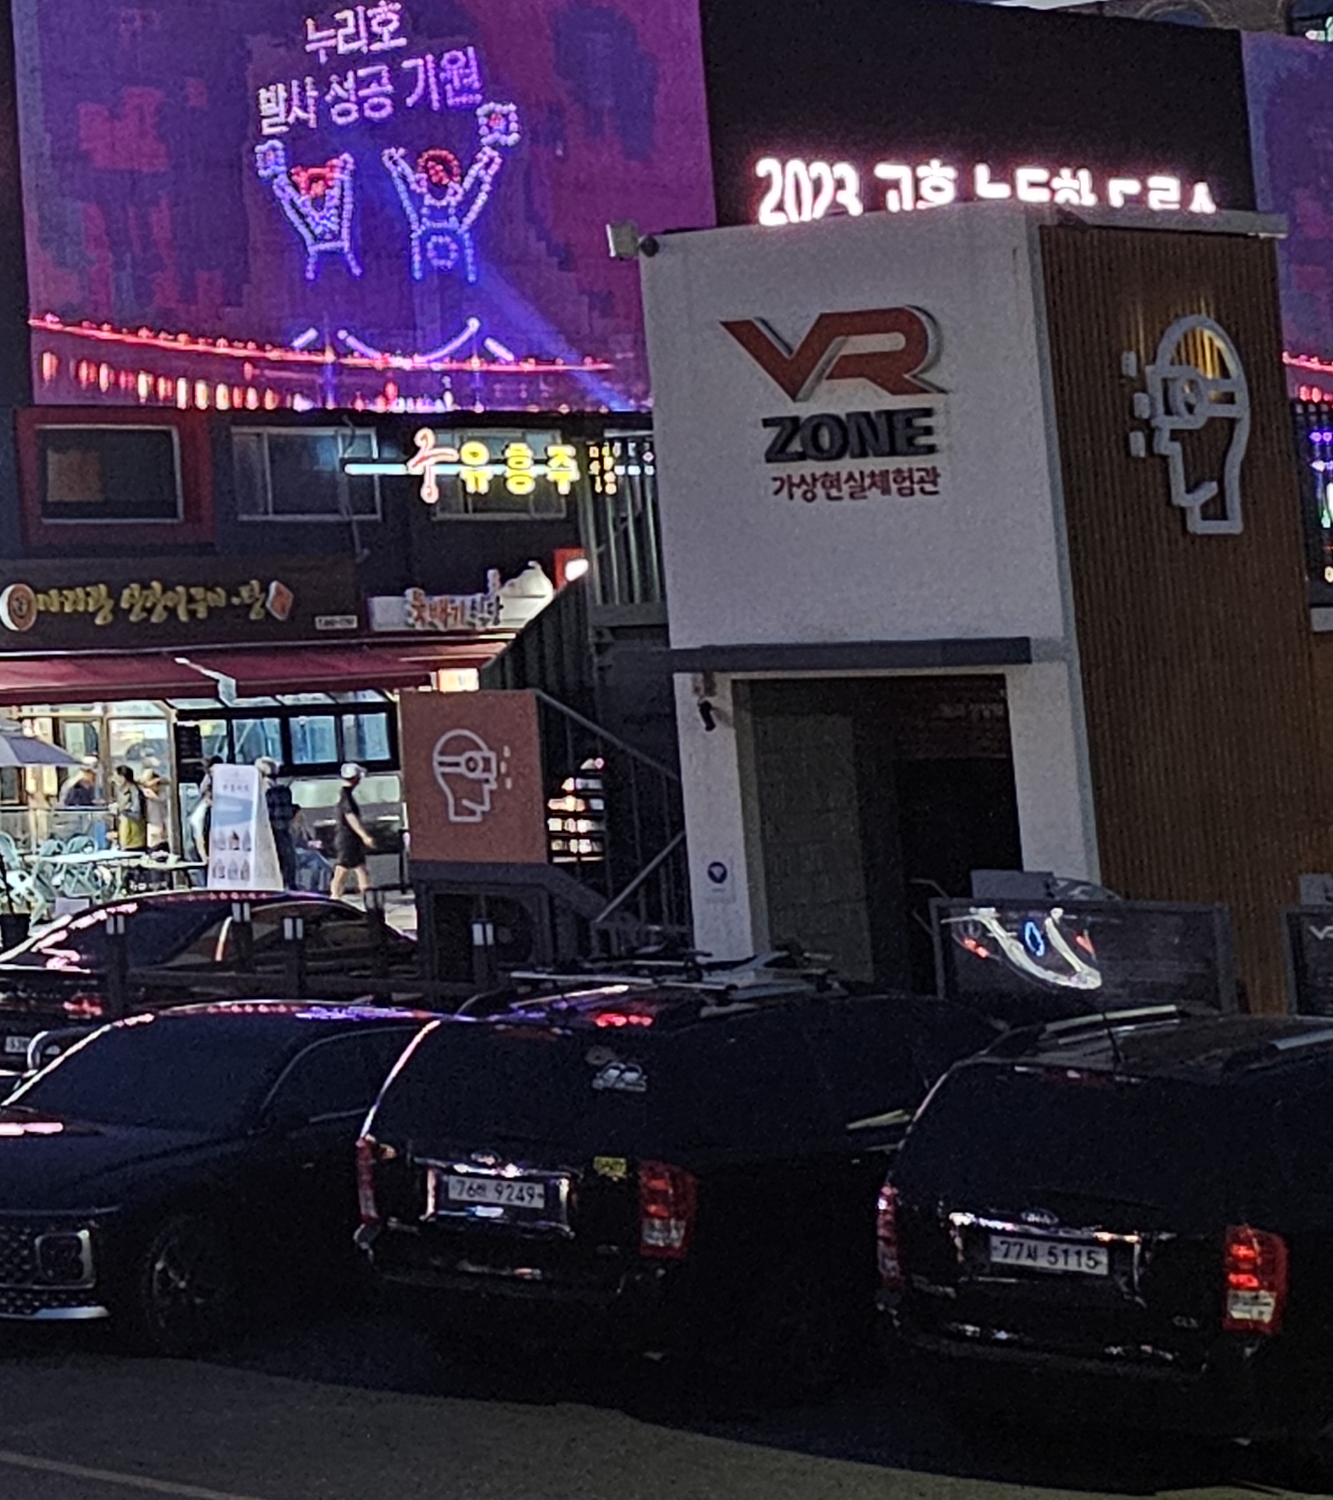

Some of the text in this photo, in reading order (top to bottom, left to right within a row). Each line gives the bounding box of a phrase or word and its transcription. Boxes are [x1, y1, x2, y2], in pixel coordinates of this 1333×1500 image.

[305, 0, 408, 64] 누리호
[258, 46, 484, 136] 발사 성공 기원
[754, 156, 864, 227] 2023
[719, 305, 947, 403] VR
[761, 408, 939, 464] ZONE
[772, 466, 941, 503] 가상현실체험관
[494, 1182, 536, 1205] 9249
[1046, 1245, 1099, 1270] 5115
